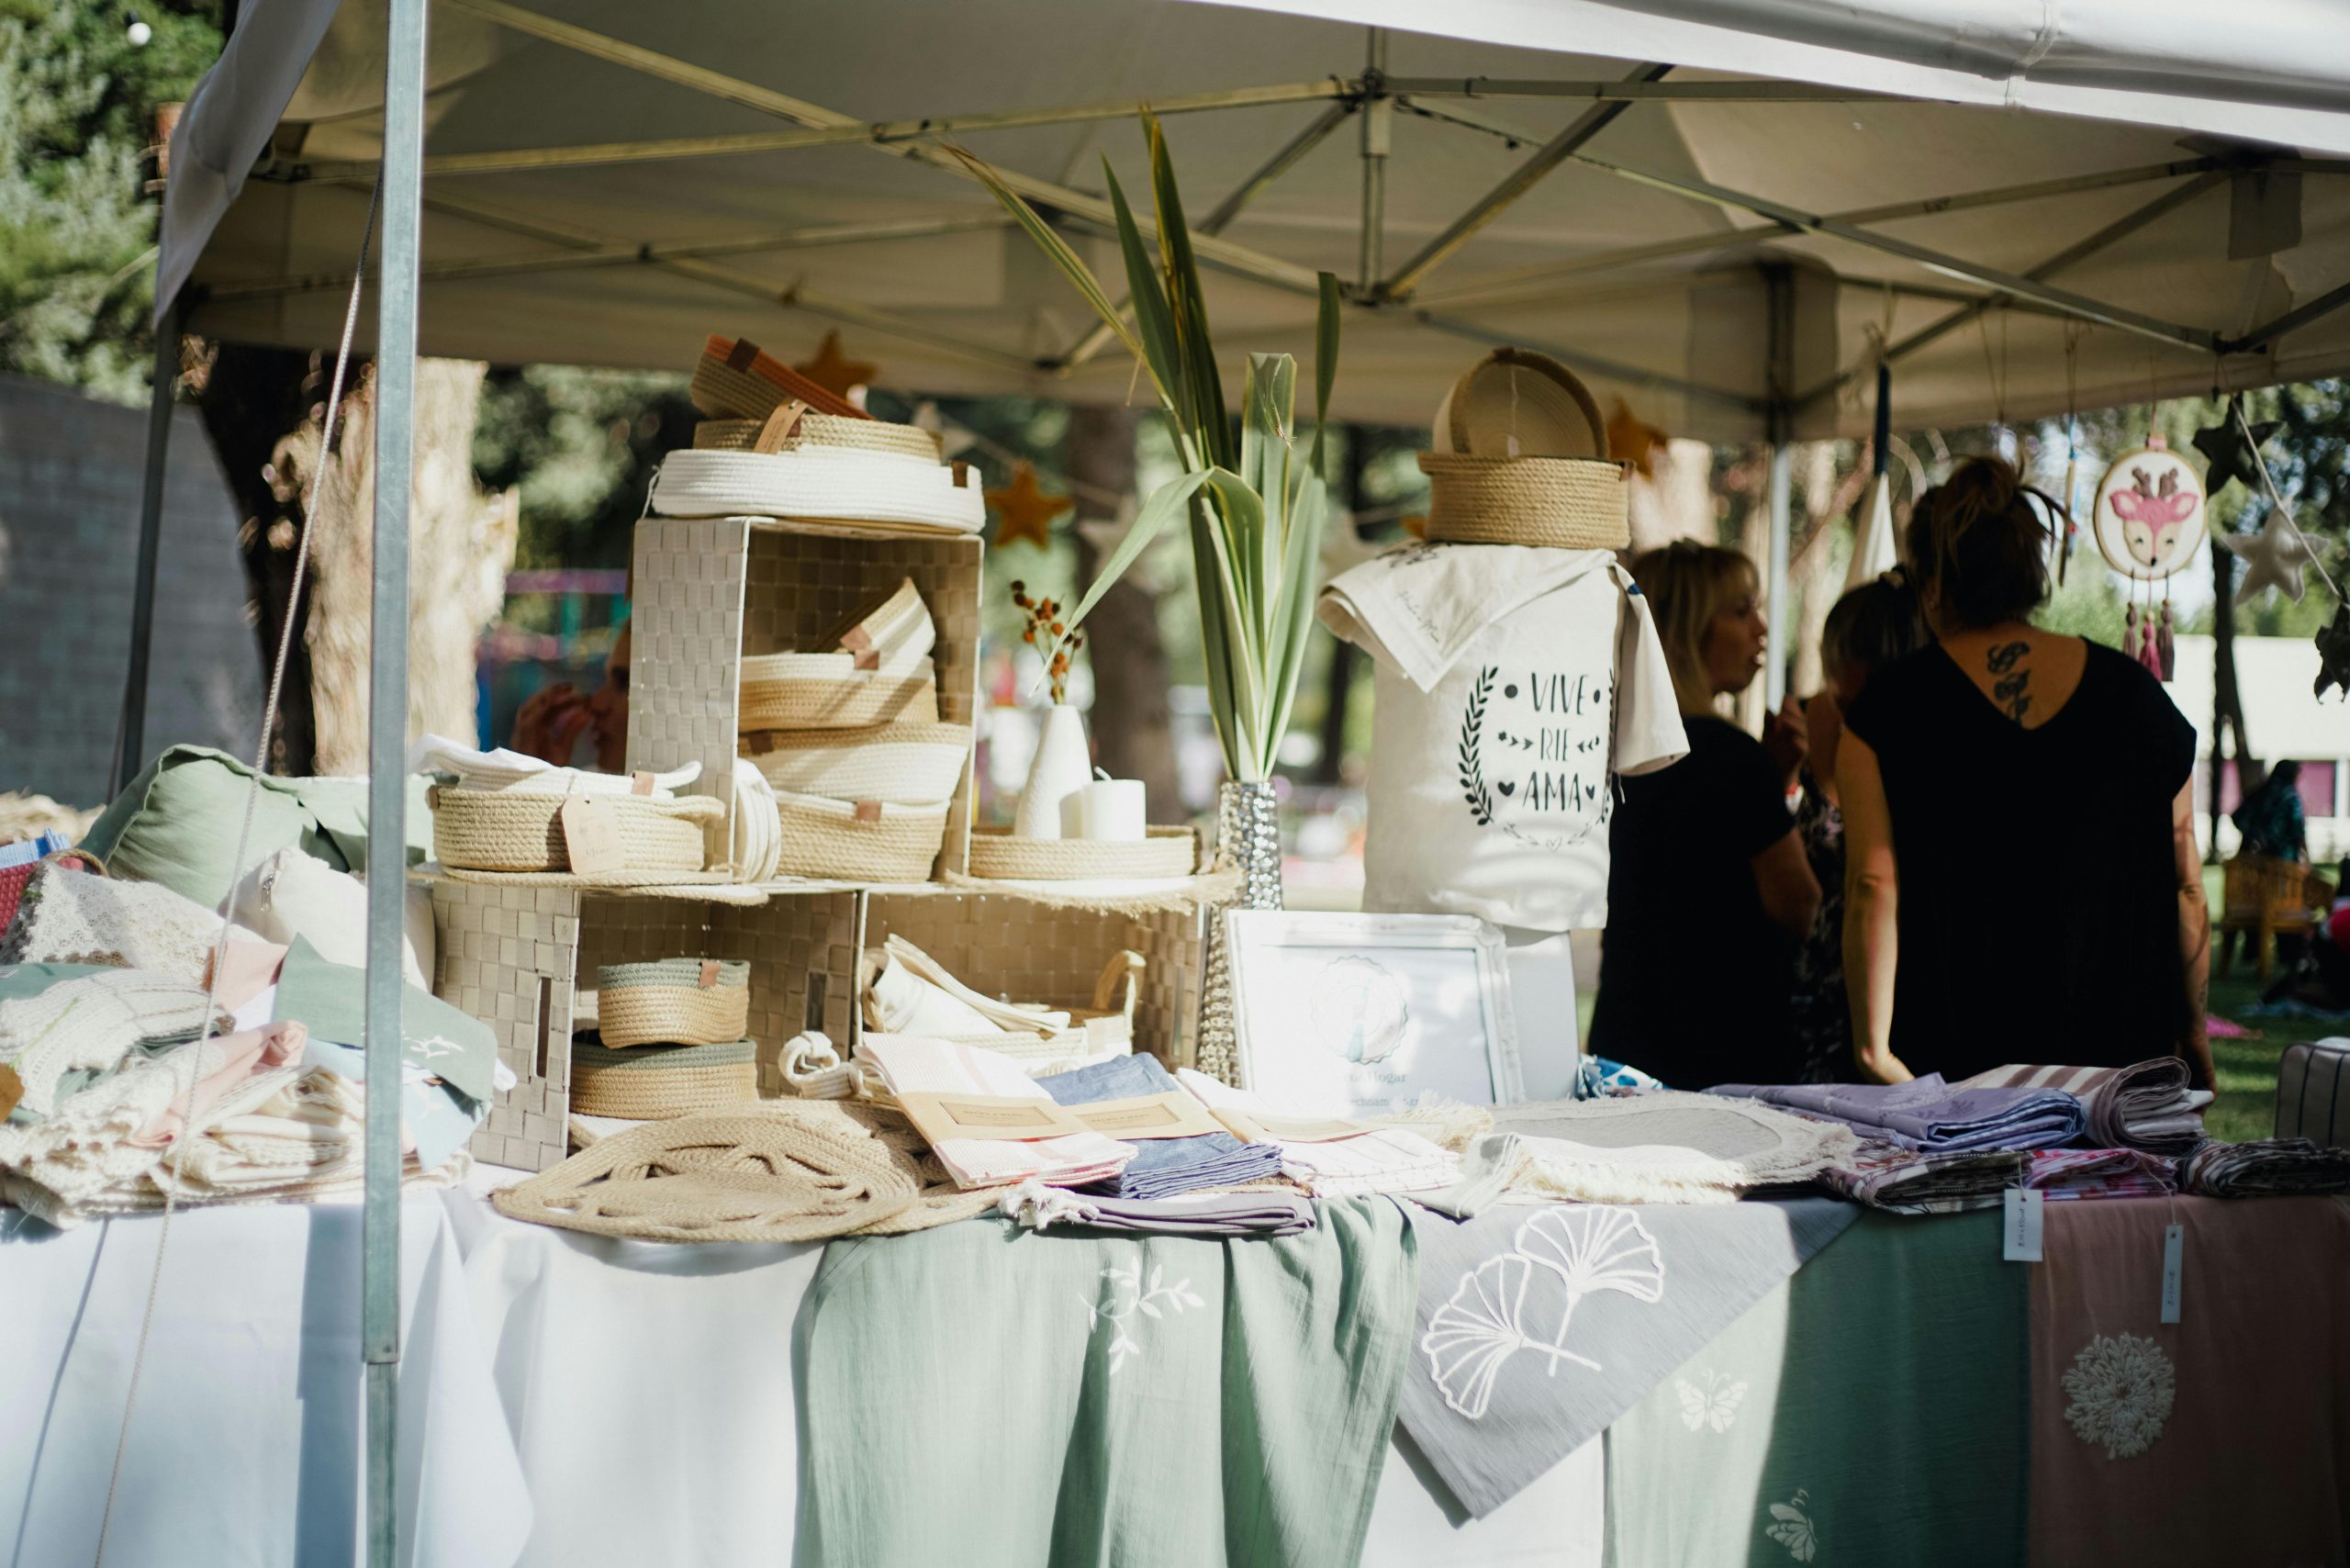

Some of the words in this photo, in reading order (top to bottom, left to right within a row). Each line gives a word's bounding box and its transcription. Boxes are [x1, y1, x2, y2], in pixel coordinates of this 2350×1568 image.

[1531, 672, 1589, 715] VIVE
[1540, 727, 1571, 761] RIE
[1522, 771, 1581, 812] AMA
